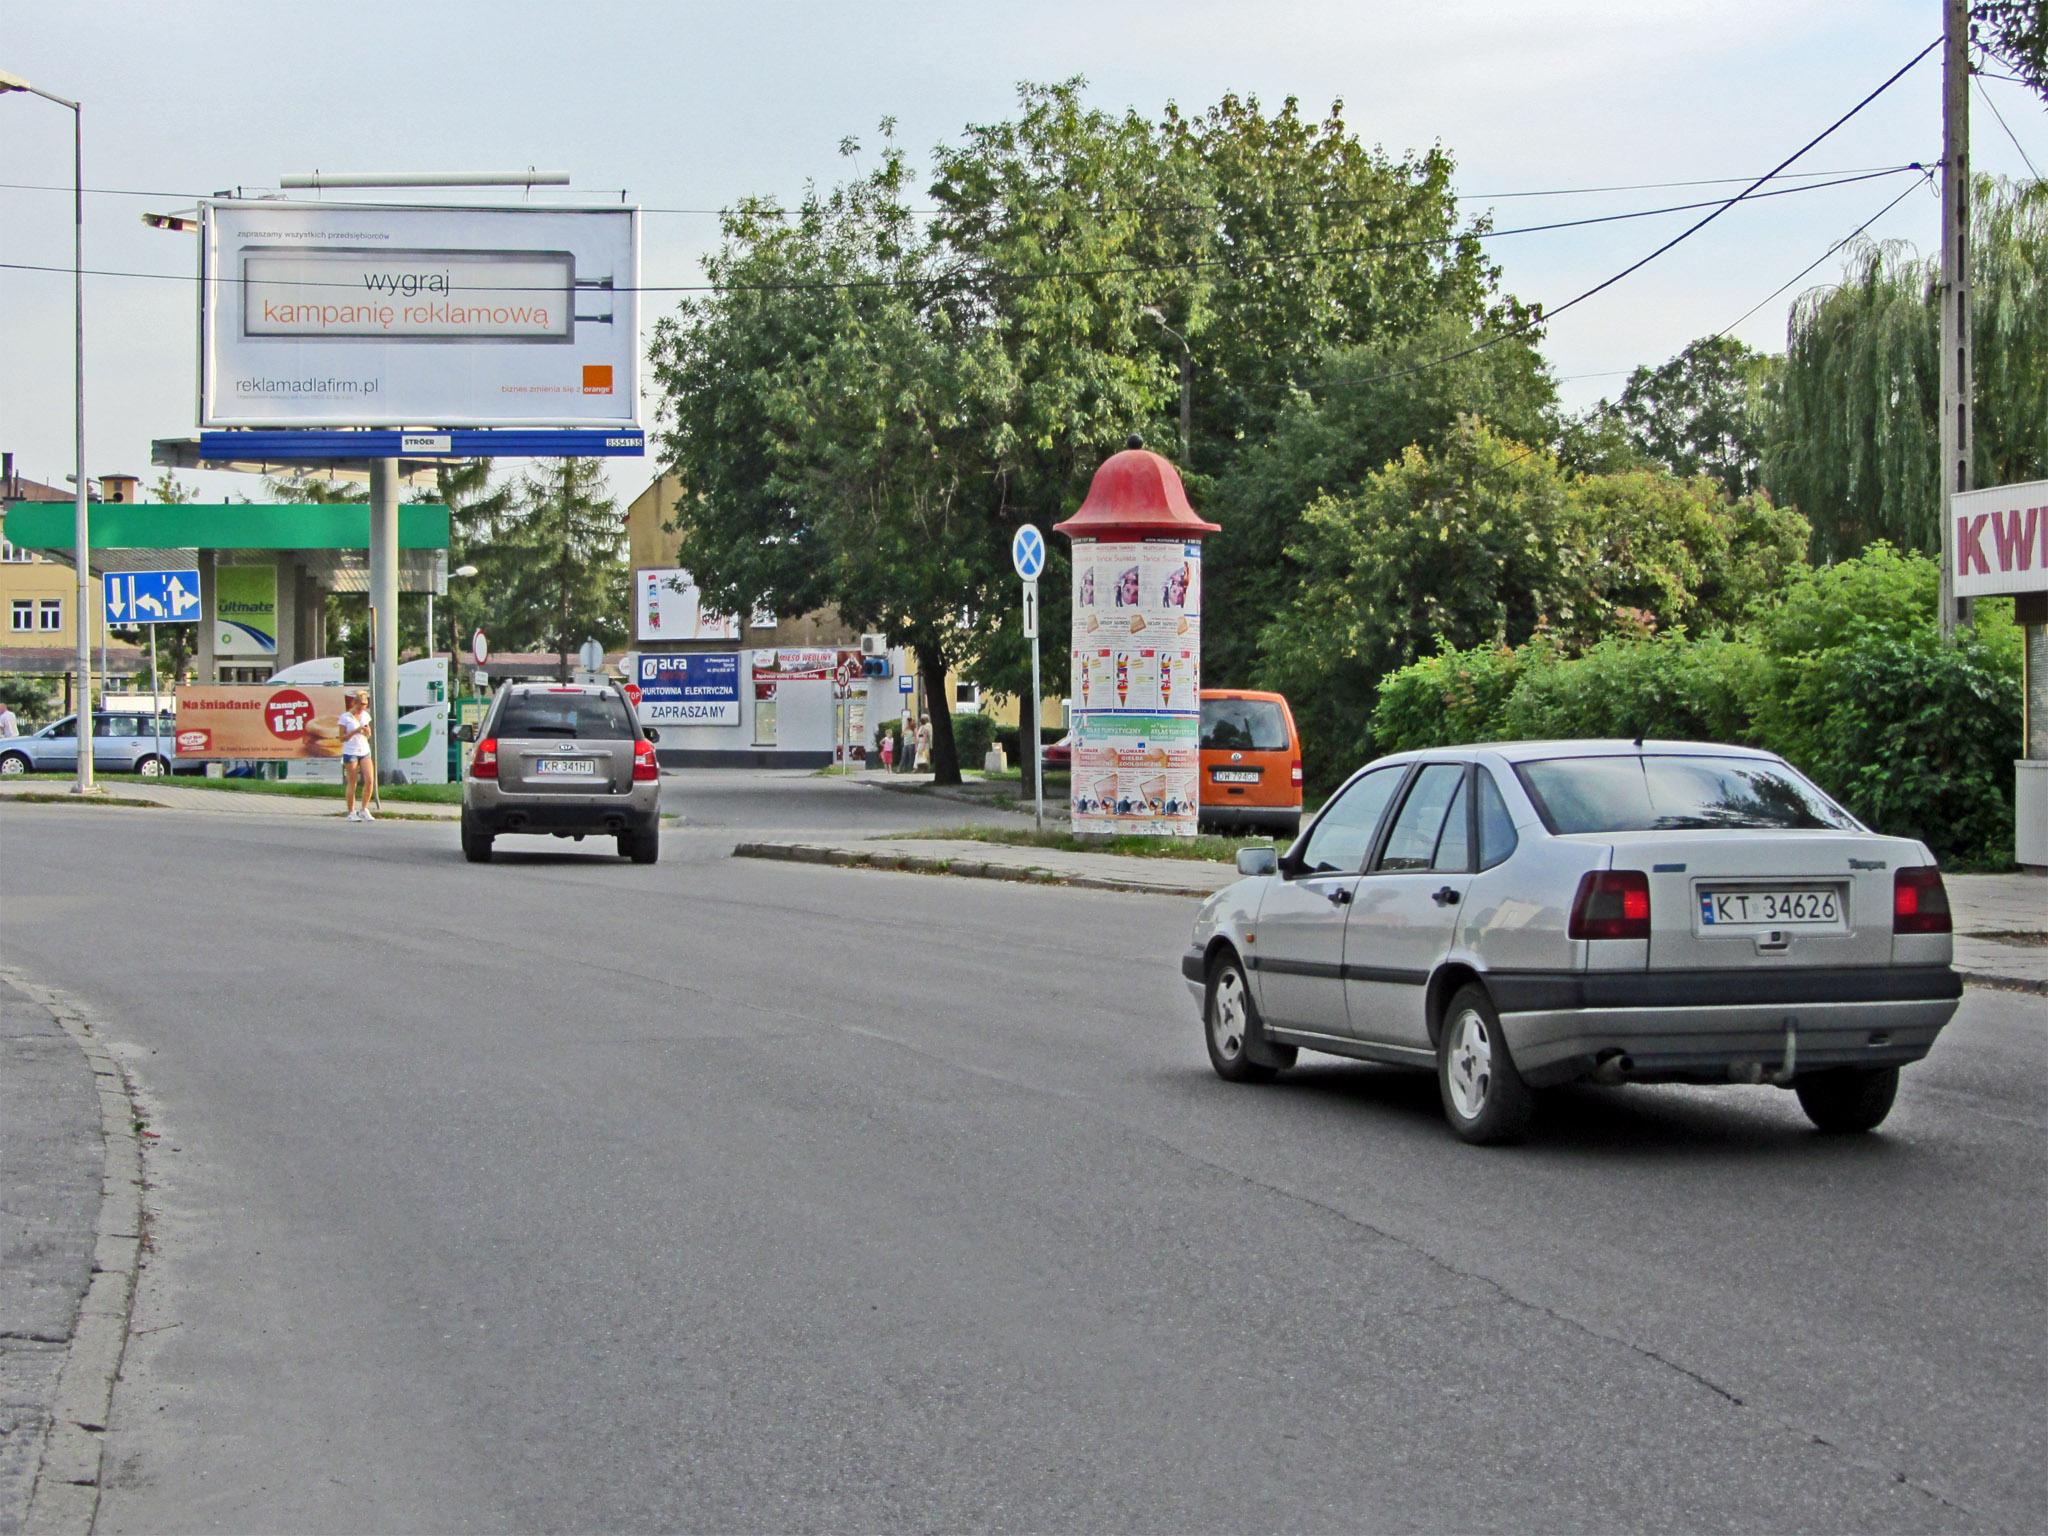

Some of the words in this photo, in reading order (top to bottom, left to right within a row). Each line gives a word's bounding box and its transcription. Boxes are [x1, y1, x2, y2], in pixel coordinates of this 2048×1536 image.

[284, 231, 327, 239] wszystkich
[328, 232, 390, 241] przedsiębiorców
[363, 270, 450, 297] wygraj
[264, 300, 394, 329] kampanię
[403, 302, 550, 330] reklamową
[236, 377, 379, 396] reklamadlafirm.pl
[501, 384, 527, 392] biznes
[530, 384, 560, 392] zmienia
[583, 386, 610, 395] orange
[218, 601, 274, 612] ultimate
[641, 687, 682, 695] HURTOWNIA
[684, 686, 734, 695] ELEKTRYCZNA
[182, 701, 198, 710] Na
[200, 699, 261, 710] śniadanie
[651, 706, 725, 718] ZAPRASZAMY
[273, 715, 284, 732] 1
[544, 760, 559, 771] KR
[562, 761, 592, 772] 341HJ
[1716, 896, 1750, 919] KT
[1763, 894, 1835, 919] 34626
